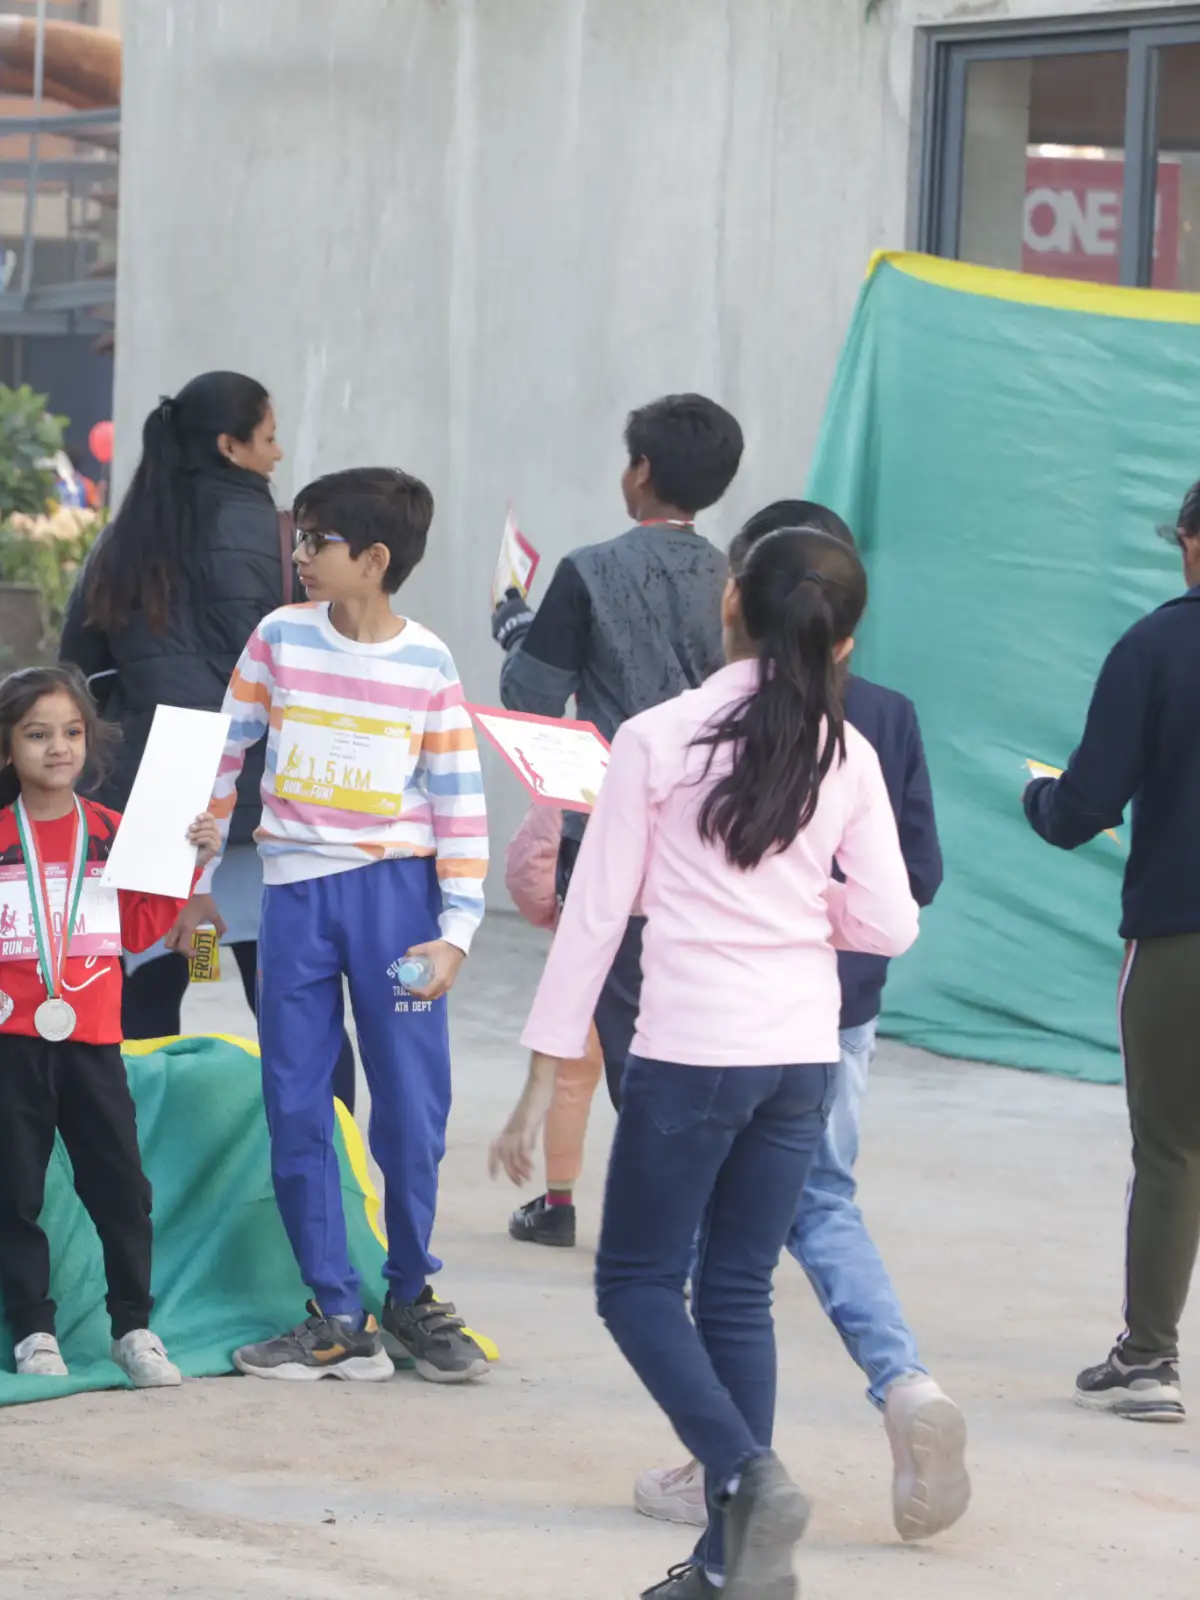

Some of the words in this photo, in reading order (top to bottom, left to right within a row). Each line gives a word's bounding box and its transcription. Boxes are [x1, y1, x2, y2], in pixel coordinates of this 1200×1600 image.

[1023, 188, 1118, 255] ONE
[307, 756, 336, 785] 1.5
[342, 764, 371, 790] KM
[283, 779, 302, 794] RUN
[2, 940, 22, 956] RUN
[395, 1001, 409, 1012] ATH
[412, 1000, 433, 1012] DEPT
